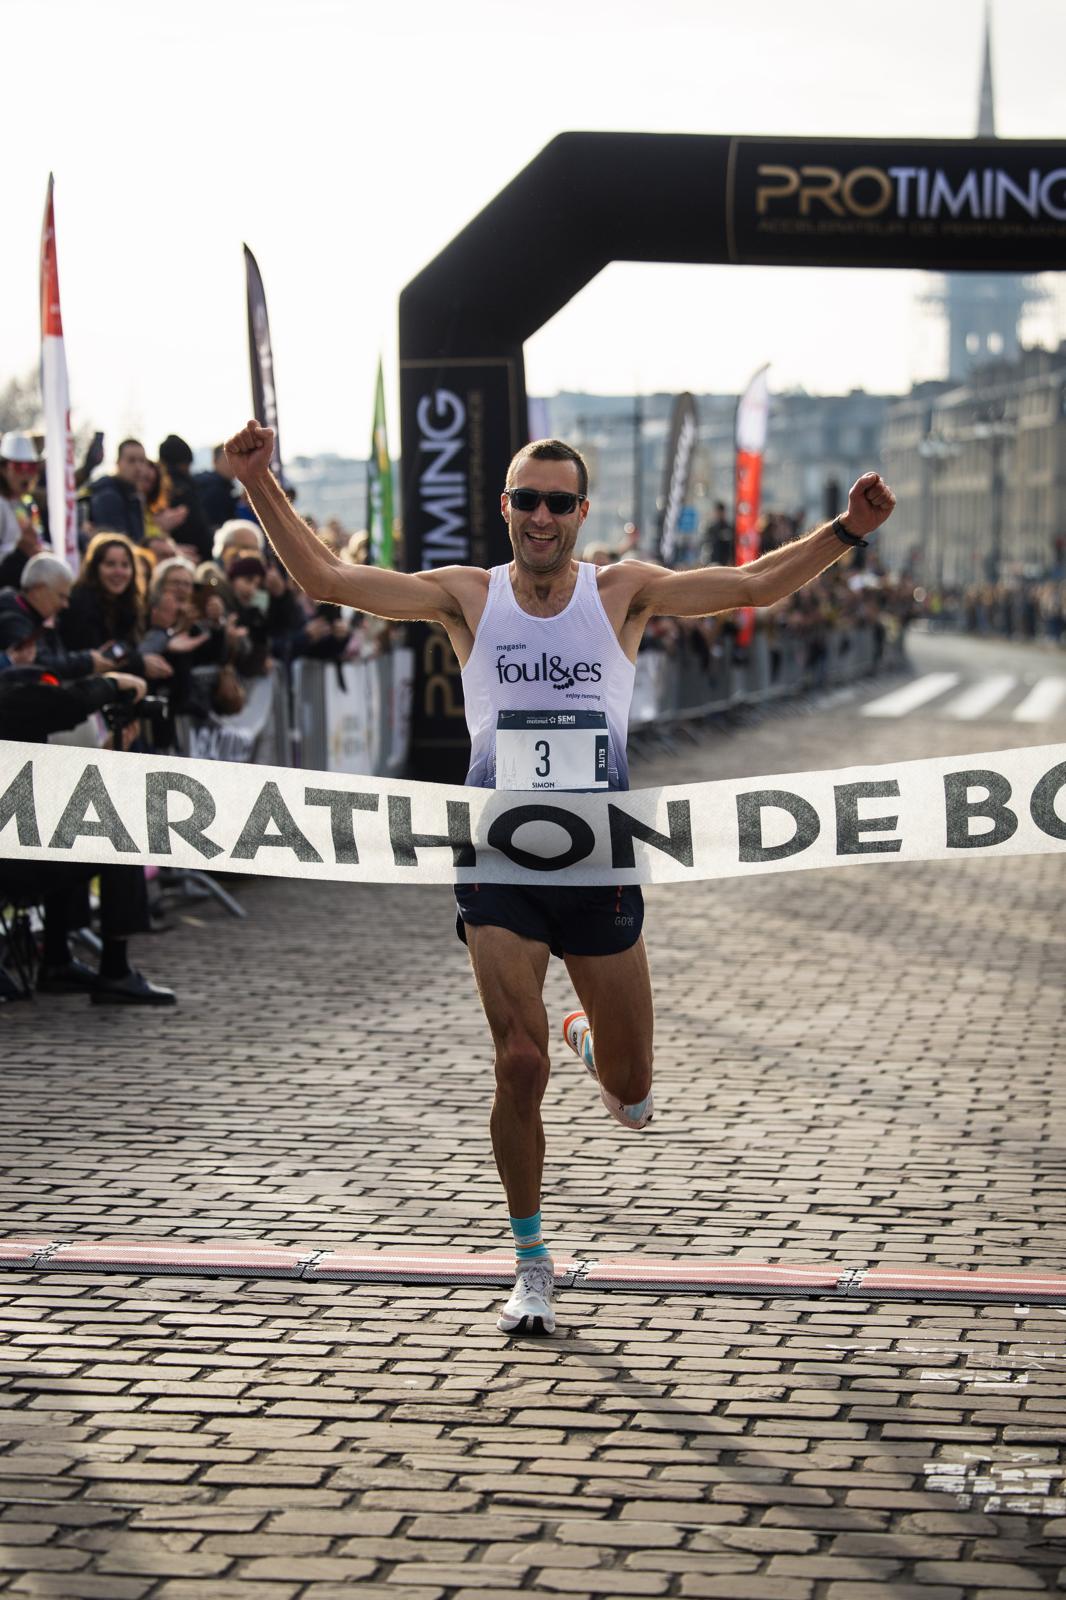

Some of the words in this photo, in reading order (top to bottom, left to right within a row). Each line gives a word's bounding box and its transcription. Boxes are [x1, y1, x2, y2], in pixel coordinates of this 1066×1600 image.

[496, 643, 526, 651] magasin
[495, 653, 602, 685] foul&es
[581, 693, 600, 701] running
[535, 740, 550, 777] 3
[598, 748, 606, 768] ELITE
[736, 779, 903, 863] DE
